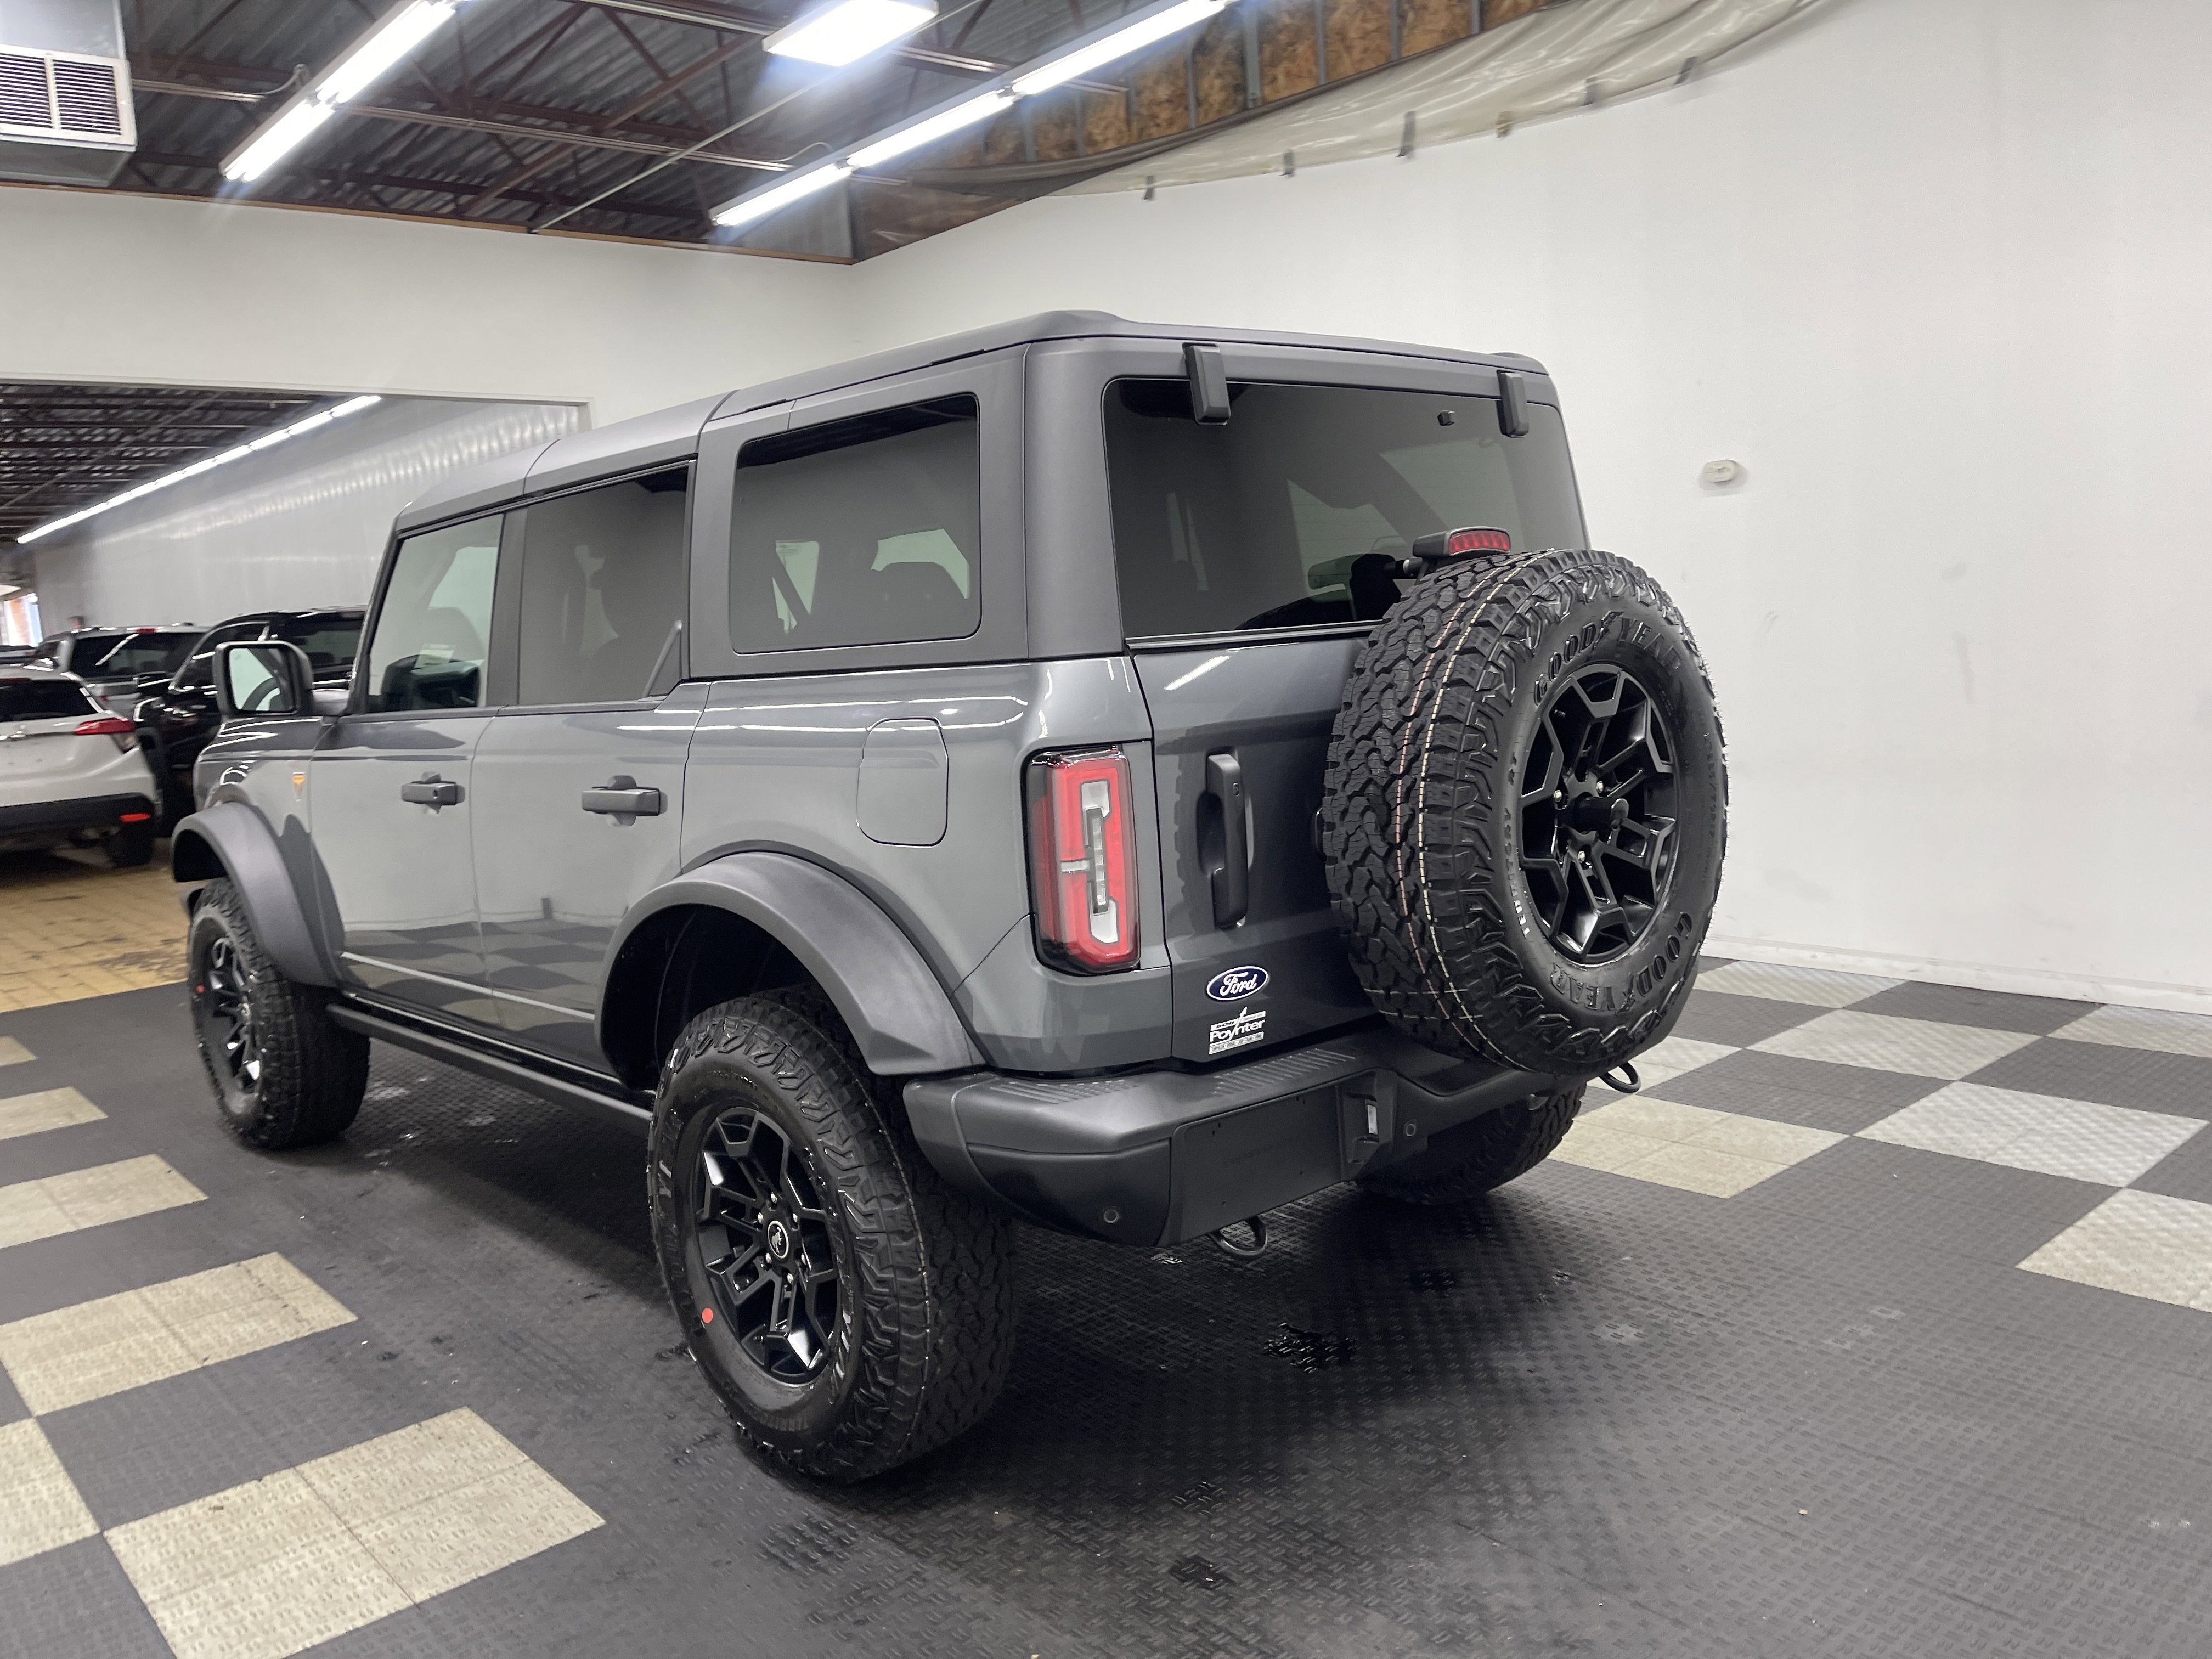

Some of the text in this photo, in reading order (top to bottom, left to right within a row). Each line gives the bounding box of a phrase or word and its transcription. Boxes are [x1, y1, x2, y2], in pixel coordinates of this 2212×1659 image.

[1533, 616, 1682, 706] GOODYEAR
[1220, 971, 1258, 996] Ford
[1210, 1019, 1266, 1042] Poynter
